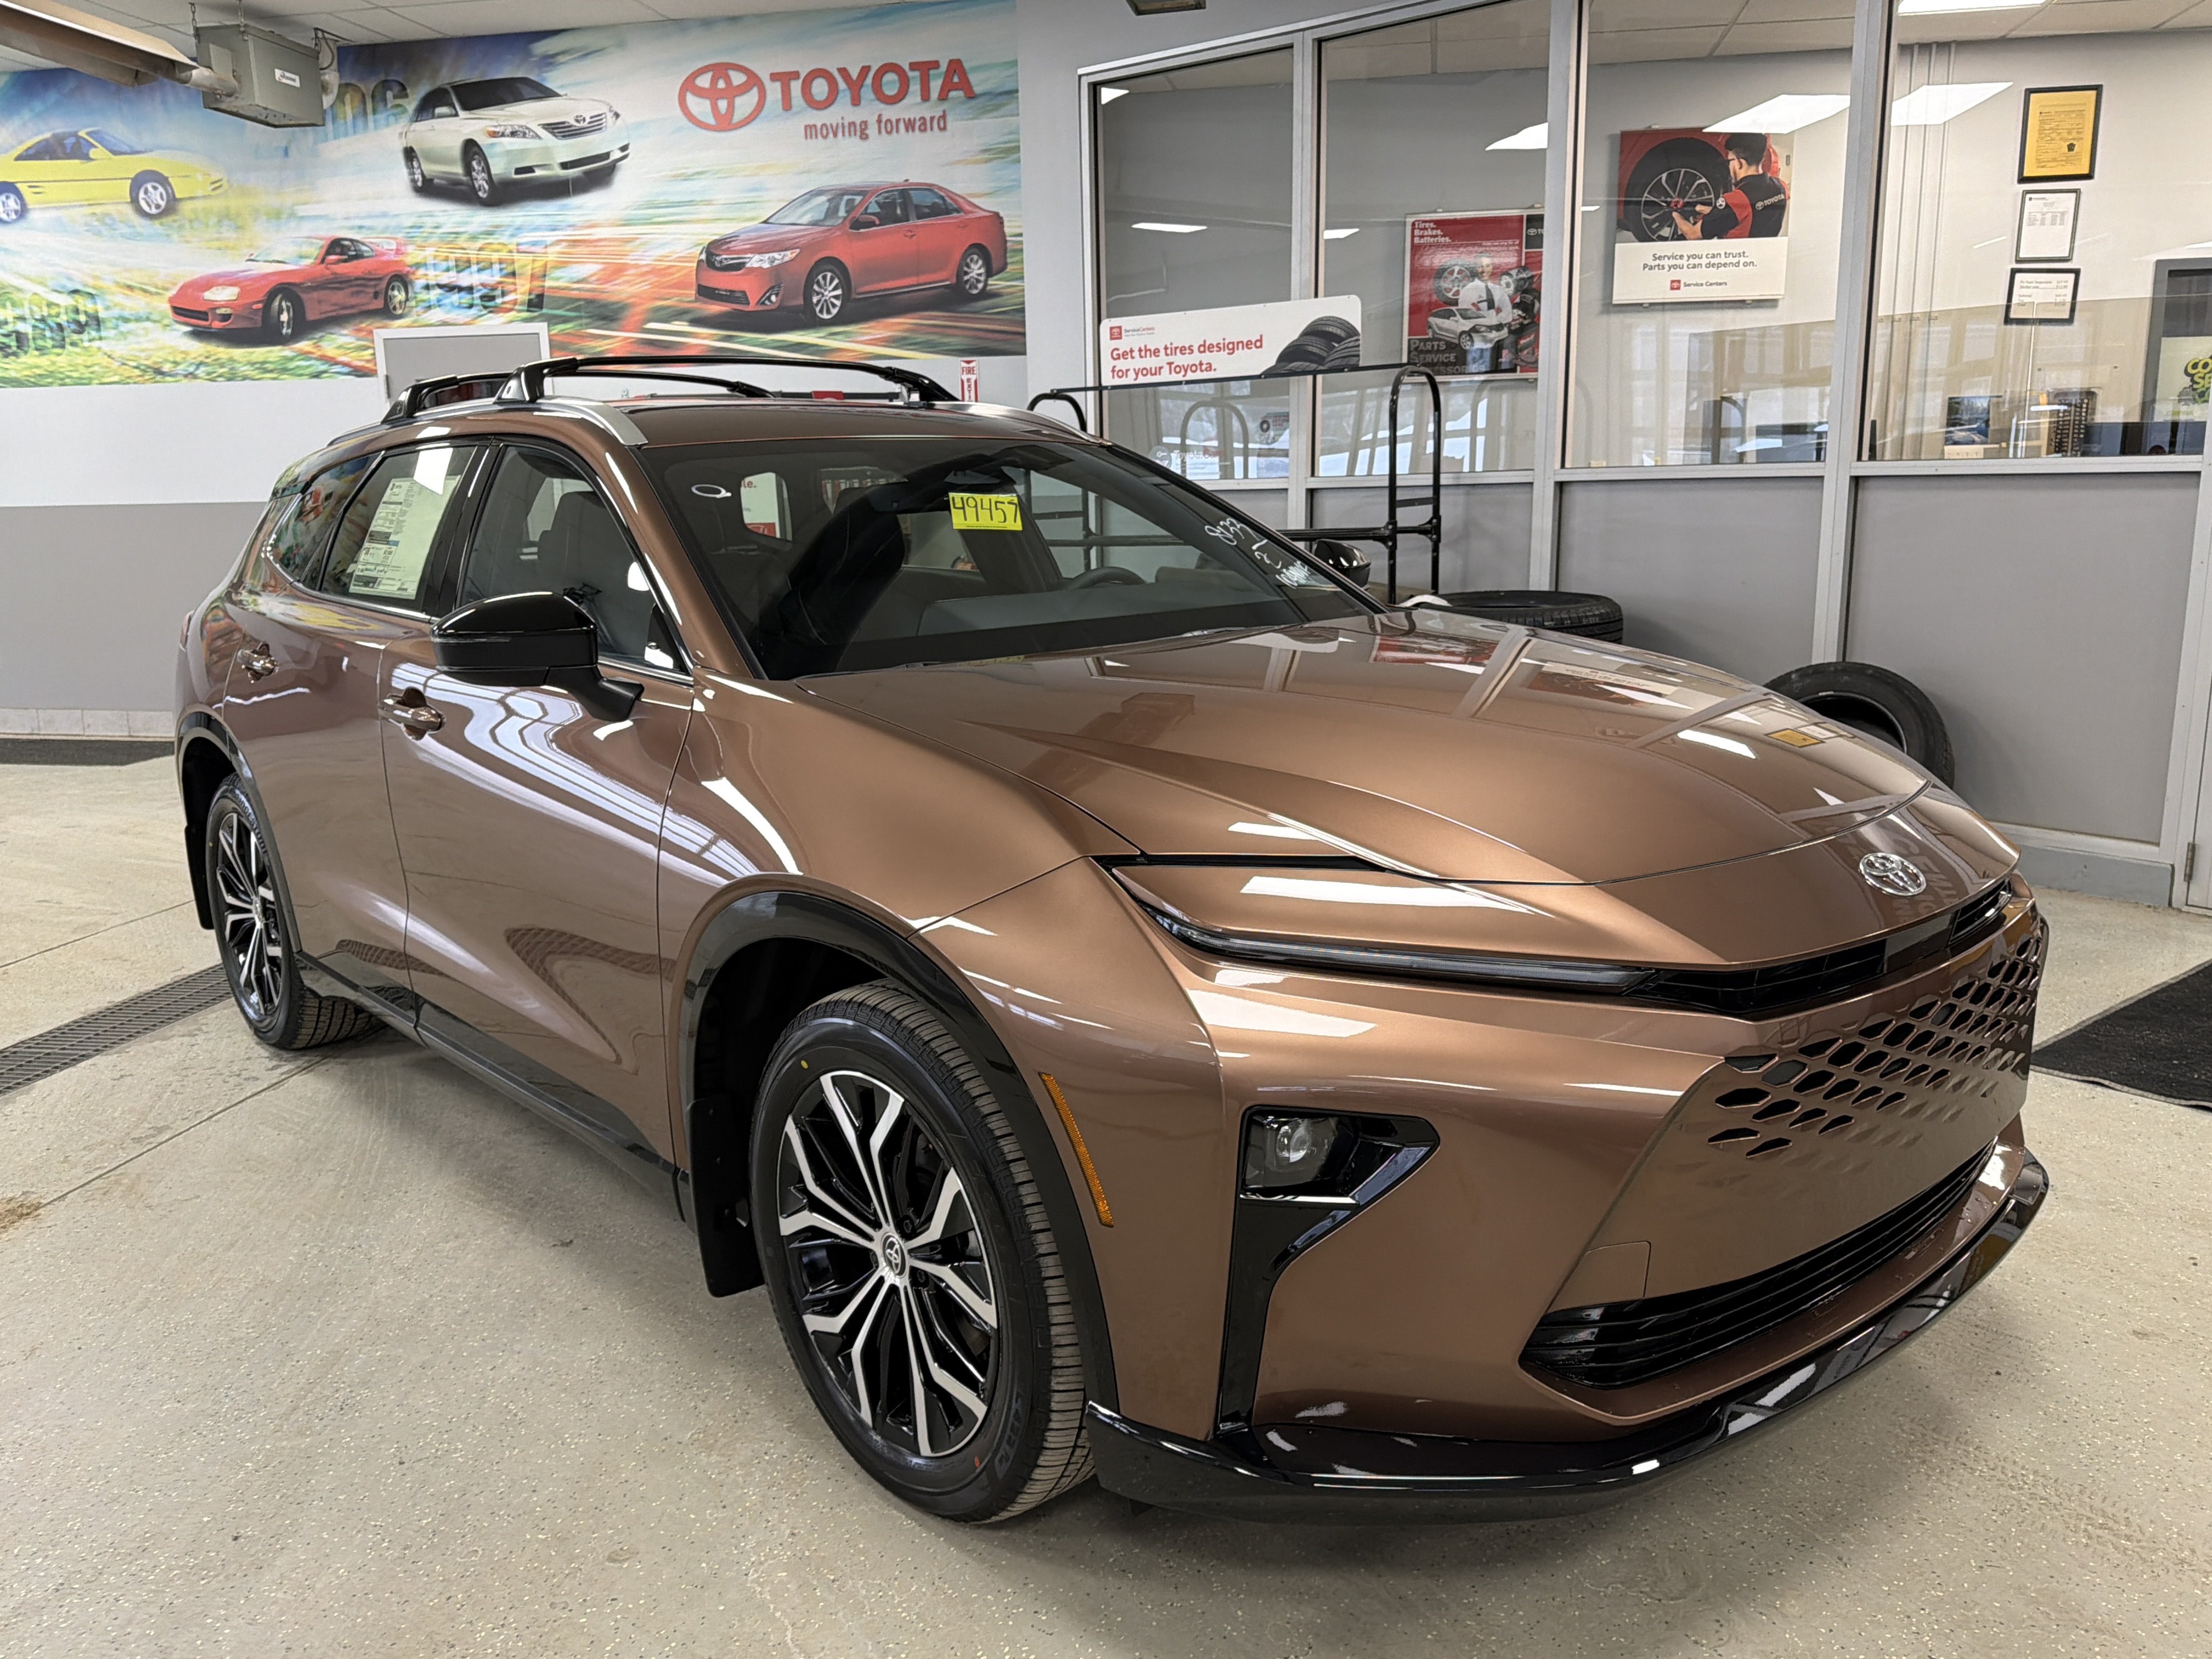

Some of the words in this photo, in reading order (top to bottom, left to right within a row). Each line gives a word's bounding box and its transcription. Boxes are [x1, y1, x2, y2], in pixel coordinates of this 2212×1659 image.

[770, 59, 975, 111] TOYOTA
[804, 117, 869, 141] moving
[876, 110, 947, 135] forward
[1764, 194, 1785, 206] TOYOTA
[1643, 263, 1666, 271] Parts
[1667, 264, 1684, 272] you
[1705, 259, 1740, 270] depend
[1652, 252, 1684, 261] Service
[1686, 253, 1703, 262] you
[1110, 347, 1136, 361] Get
[1137, 344, 1161, 359] the
[1163, 342, 1194, 357] tires
[1197, 334, 1264, 356] designed
[962, 366, 977, 375] FIRE
[1110, 365, 1131, 380] for
[1133, 365, 1164, 381] your
[1166, 360, 1217, 377] Toyota.
[952, 495, 1018, 523] 49457
